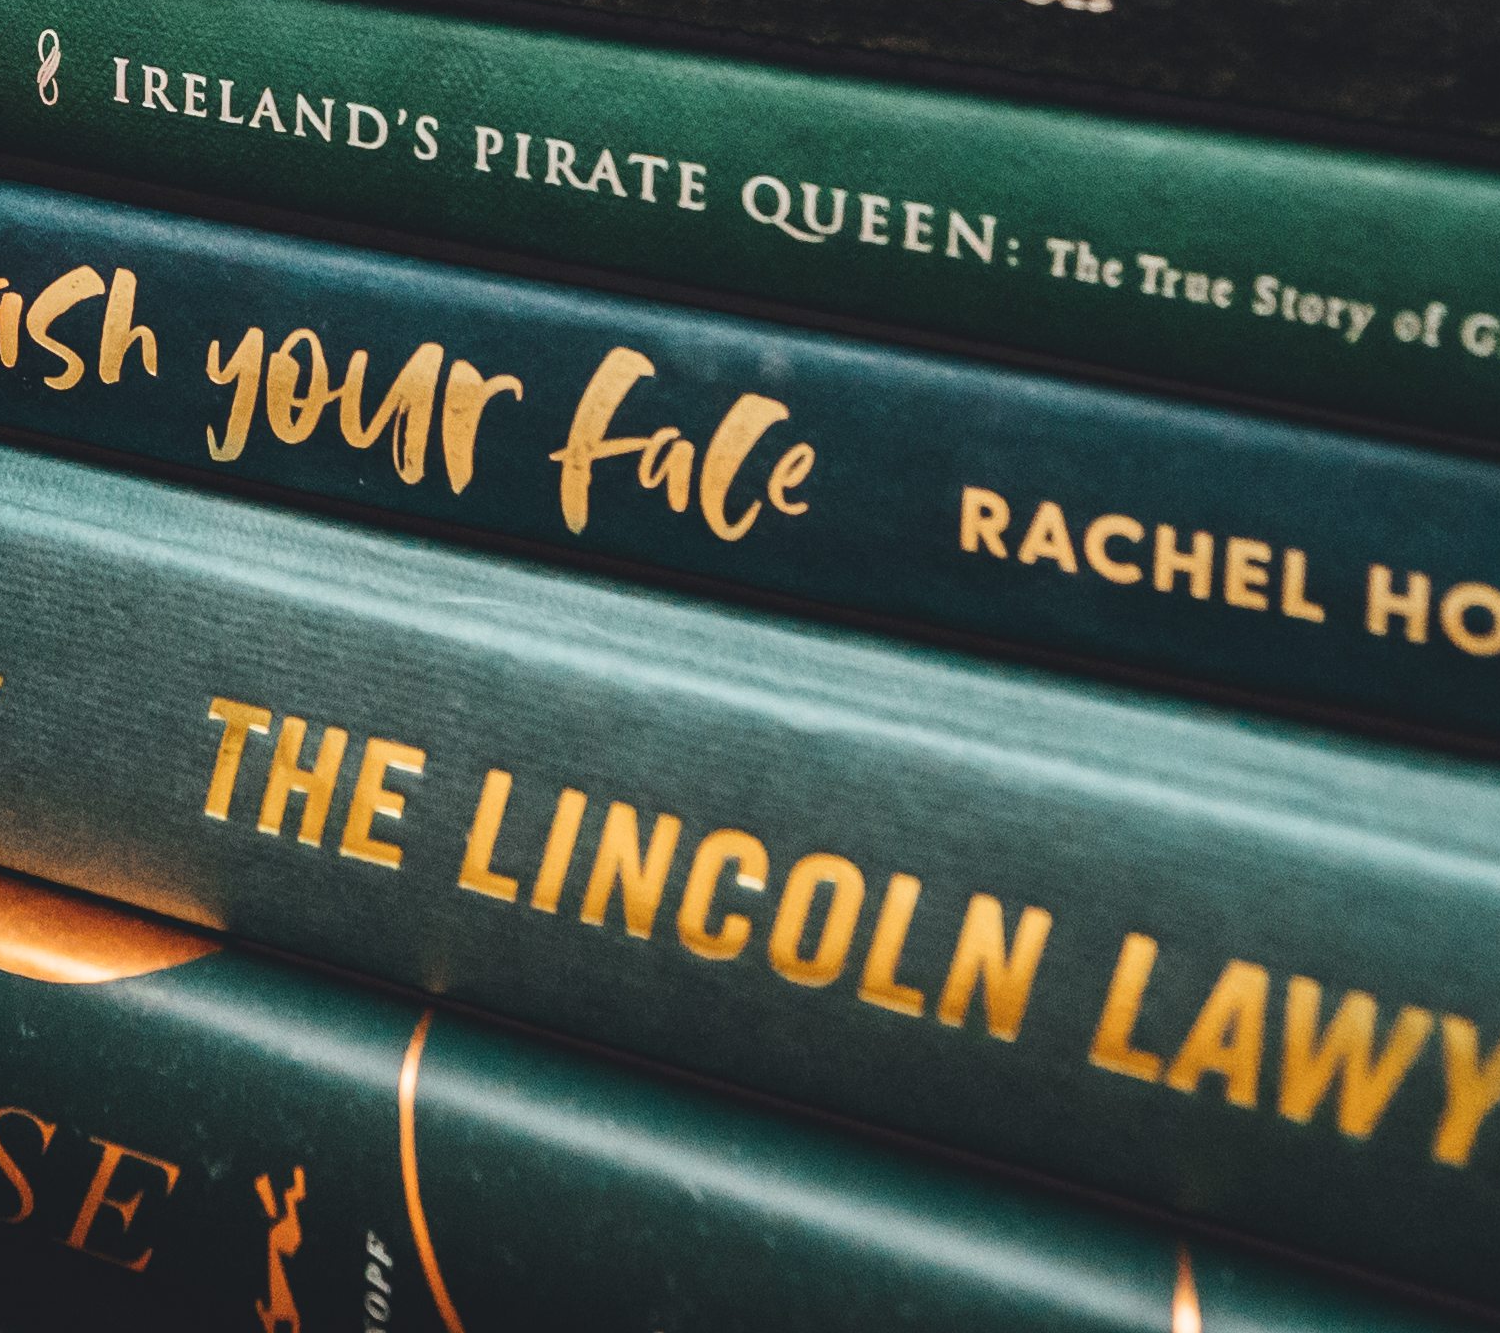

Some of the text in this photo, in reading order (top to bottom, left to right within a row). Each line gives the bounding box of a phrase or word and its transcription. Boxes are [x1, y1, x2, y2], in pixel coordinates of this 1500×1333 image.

[113, 57, 439, 160] IRELAND'S
[475, 126, 706, 211] PIRATE
[742, 175, 1019, 265] QUEEN:
[1046, 238, 1123, 287] The
[1137, 254, 1233, 308] True
[1252, 275, 1375, 342] Story
[1394, 302, 1447, 347] of
[206, 327, 523, 494] your
[549, 347, 815, 541] face
[959, 487, 1325, 622] RACHEL
[204, 697, 426, 867] THE
[458, 769, 1052, 1041] LINCOLN
